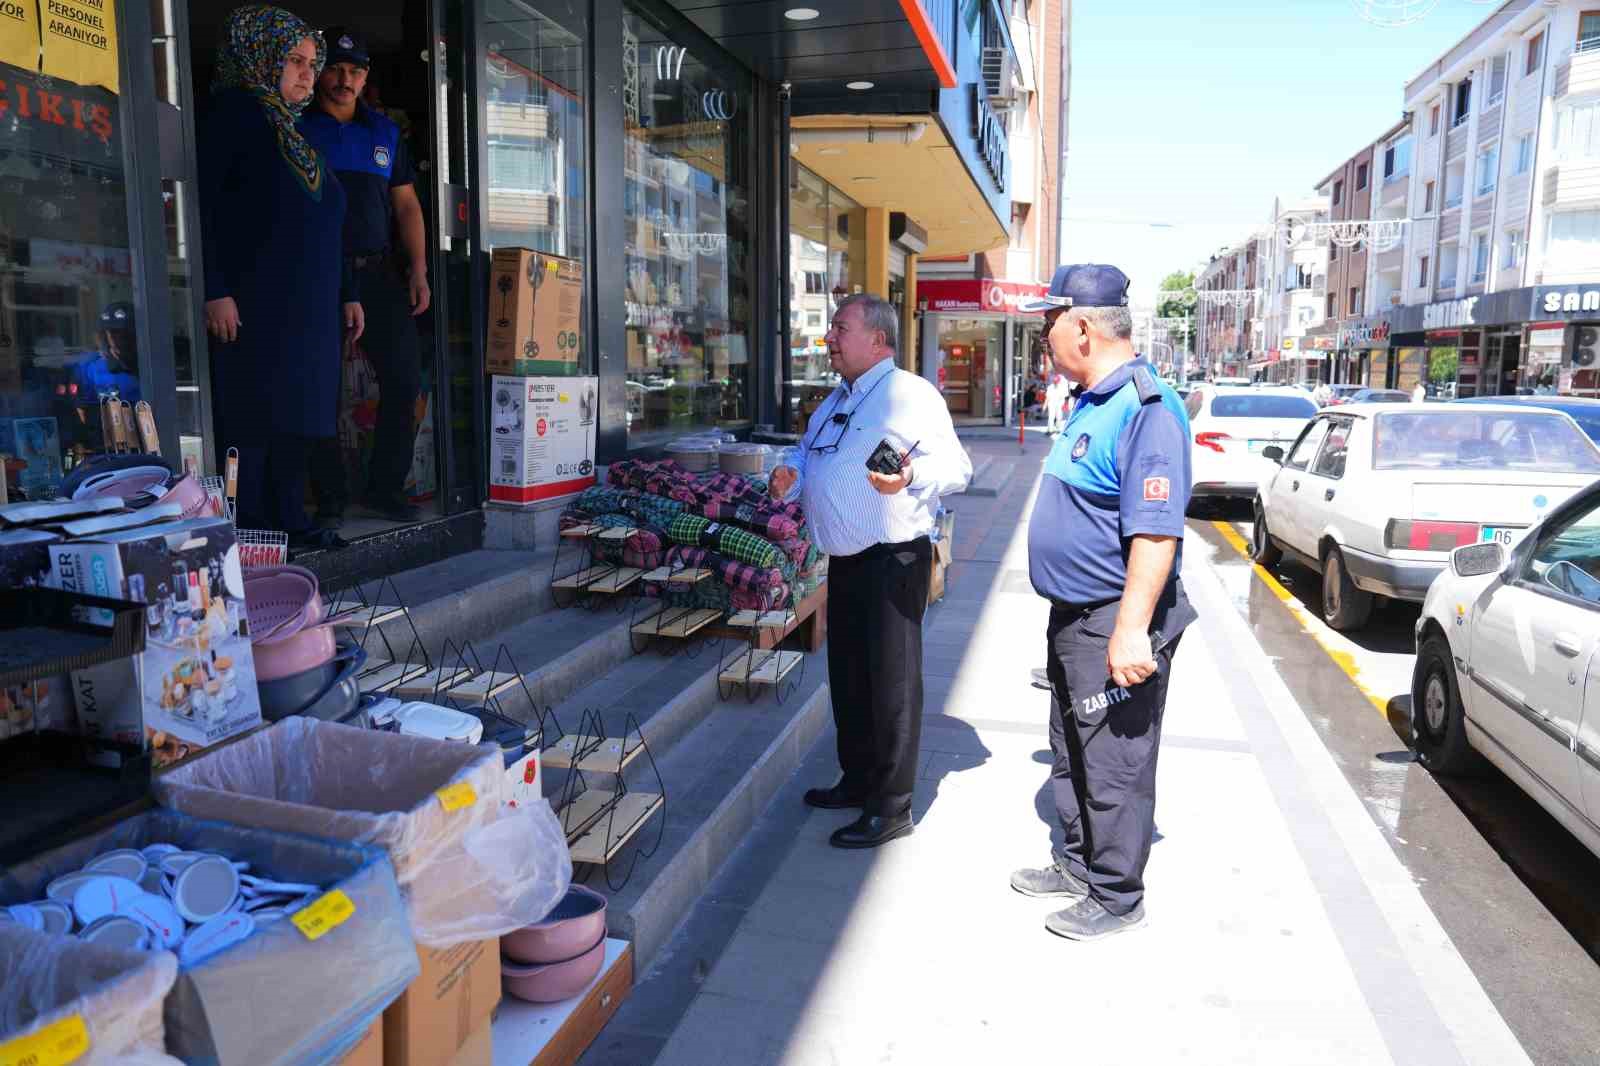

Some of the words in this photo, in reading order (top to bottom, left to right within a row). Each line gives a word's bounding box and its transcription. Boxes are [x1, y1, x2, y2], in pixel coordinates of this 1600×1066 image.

[48, 0, 104, 28] PERSONEL
[49, 20, 106, 48] ARANIYOR
[79, 677, 97, 713] KAT
[1082, 687, 1131, 714] ZABITA
